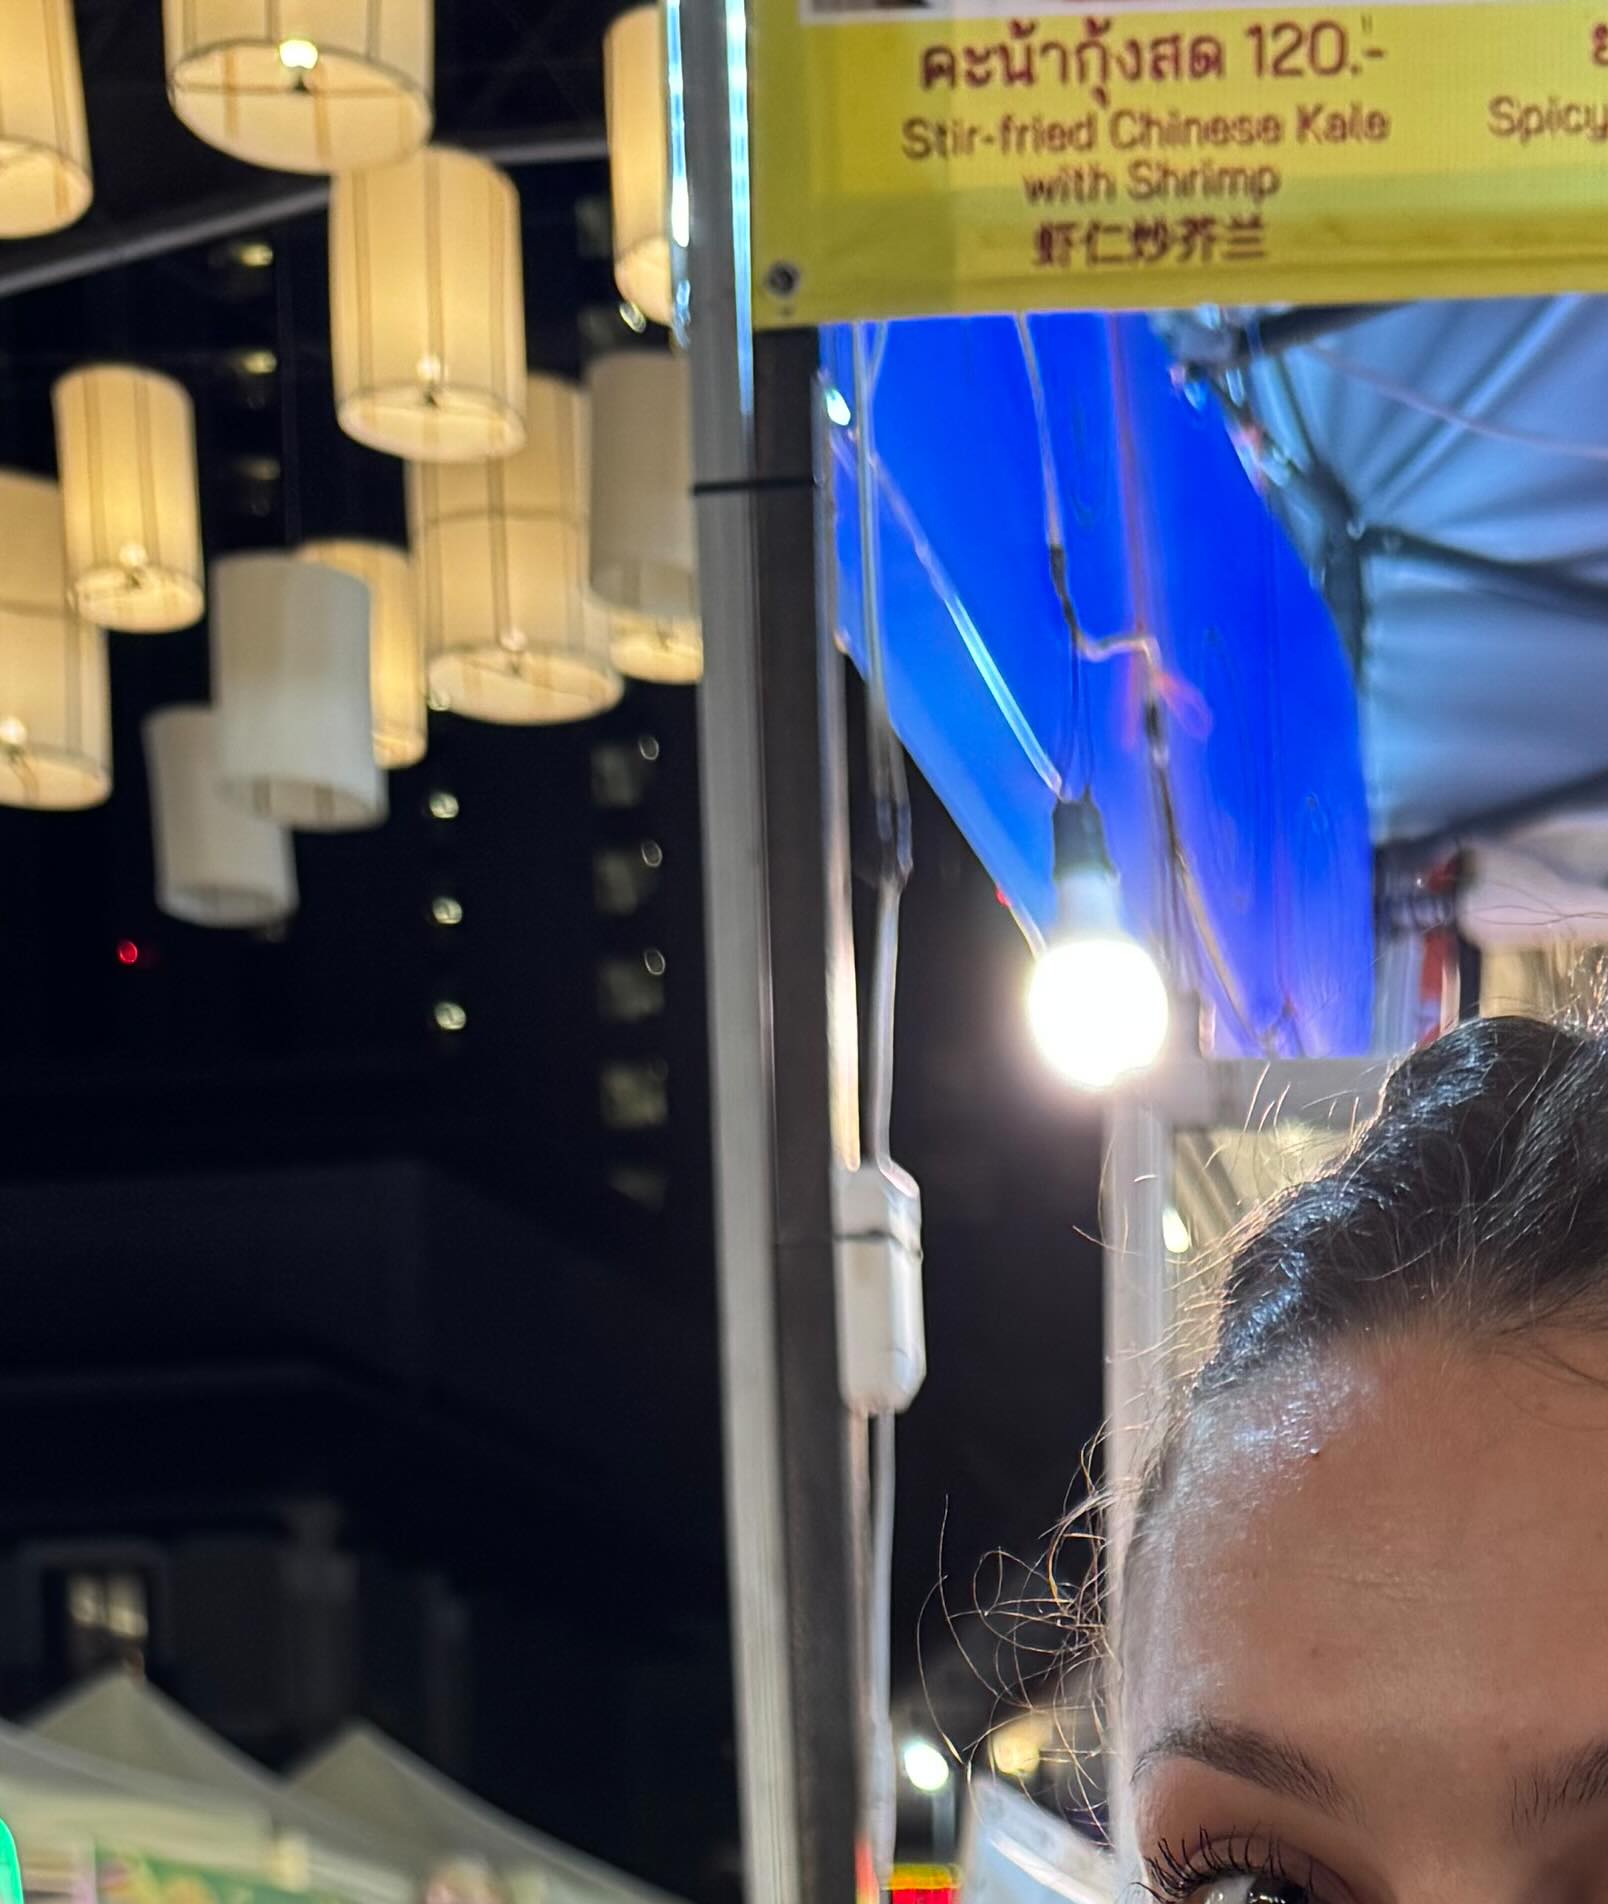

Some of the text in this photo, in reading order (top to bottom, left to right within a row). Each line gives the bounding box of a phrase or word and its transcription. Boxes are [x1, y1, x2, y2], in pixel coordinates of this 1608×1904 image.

[920, 17, 1226, 109] คะน้ากุ้งสด
[901, 103, 1391, 162] Stir-fried Chinese Kale
[1022, 160, 1281, 206] with Shrimp
